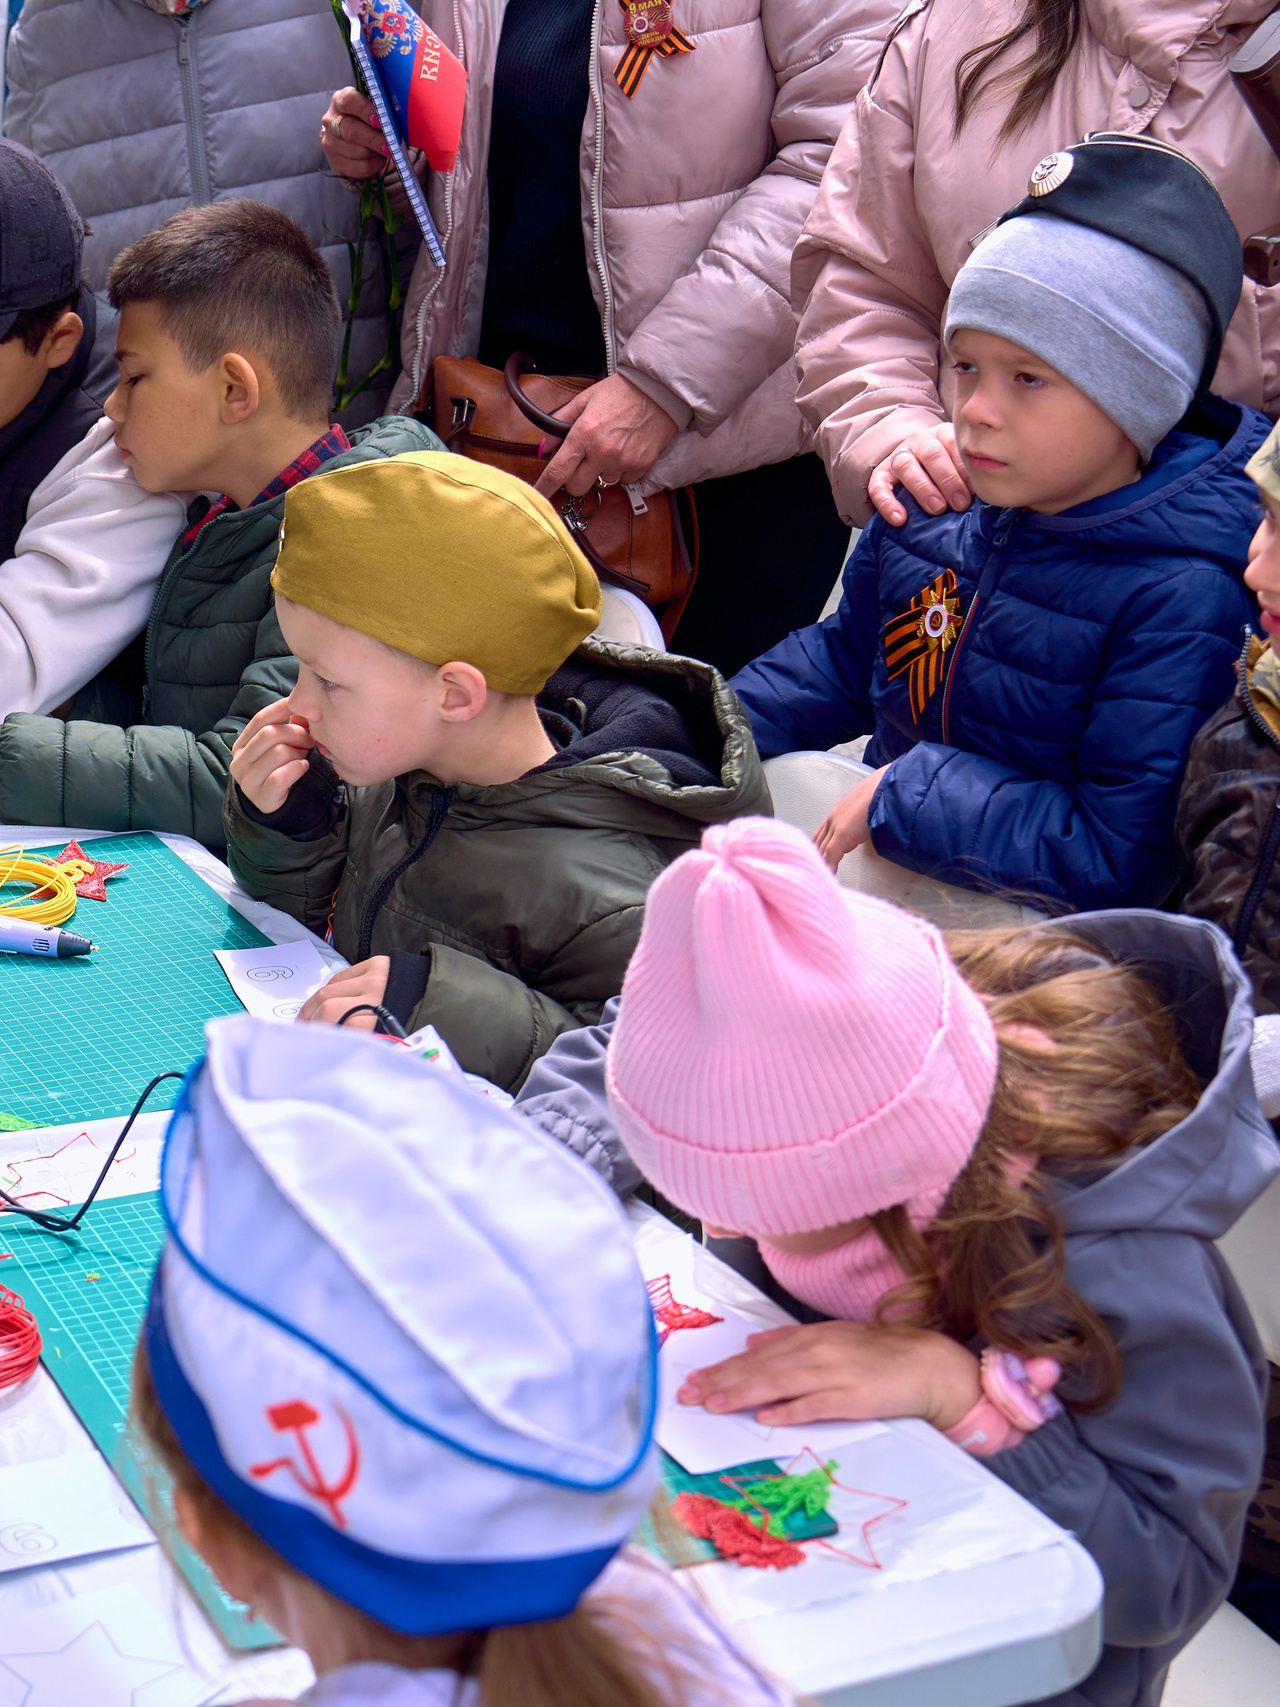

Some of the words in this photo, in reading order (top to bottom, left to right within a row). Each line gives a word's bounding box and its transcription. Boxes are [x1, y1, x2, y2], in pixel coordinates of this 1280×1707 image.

[629, 2, 637, 14] 9
[638, 0, 662, 11] МАЯ
[638, 34, 667, 46] ПОБЕДЫ
[641, 31, 660, 40] ДЕНЬ
